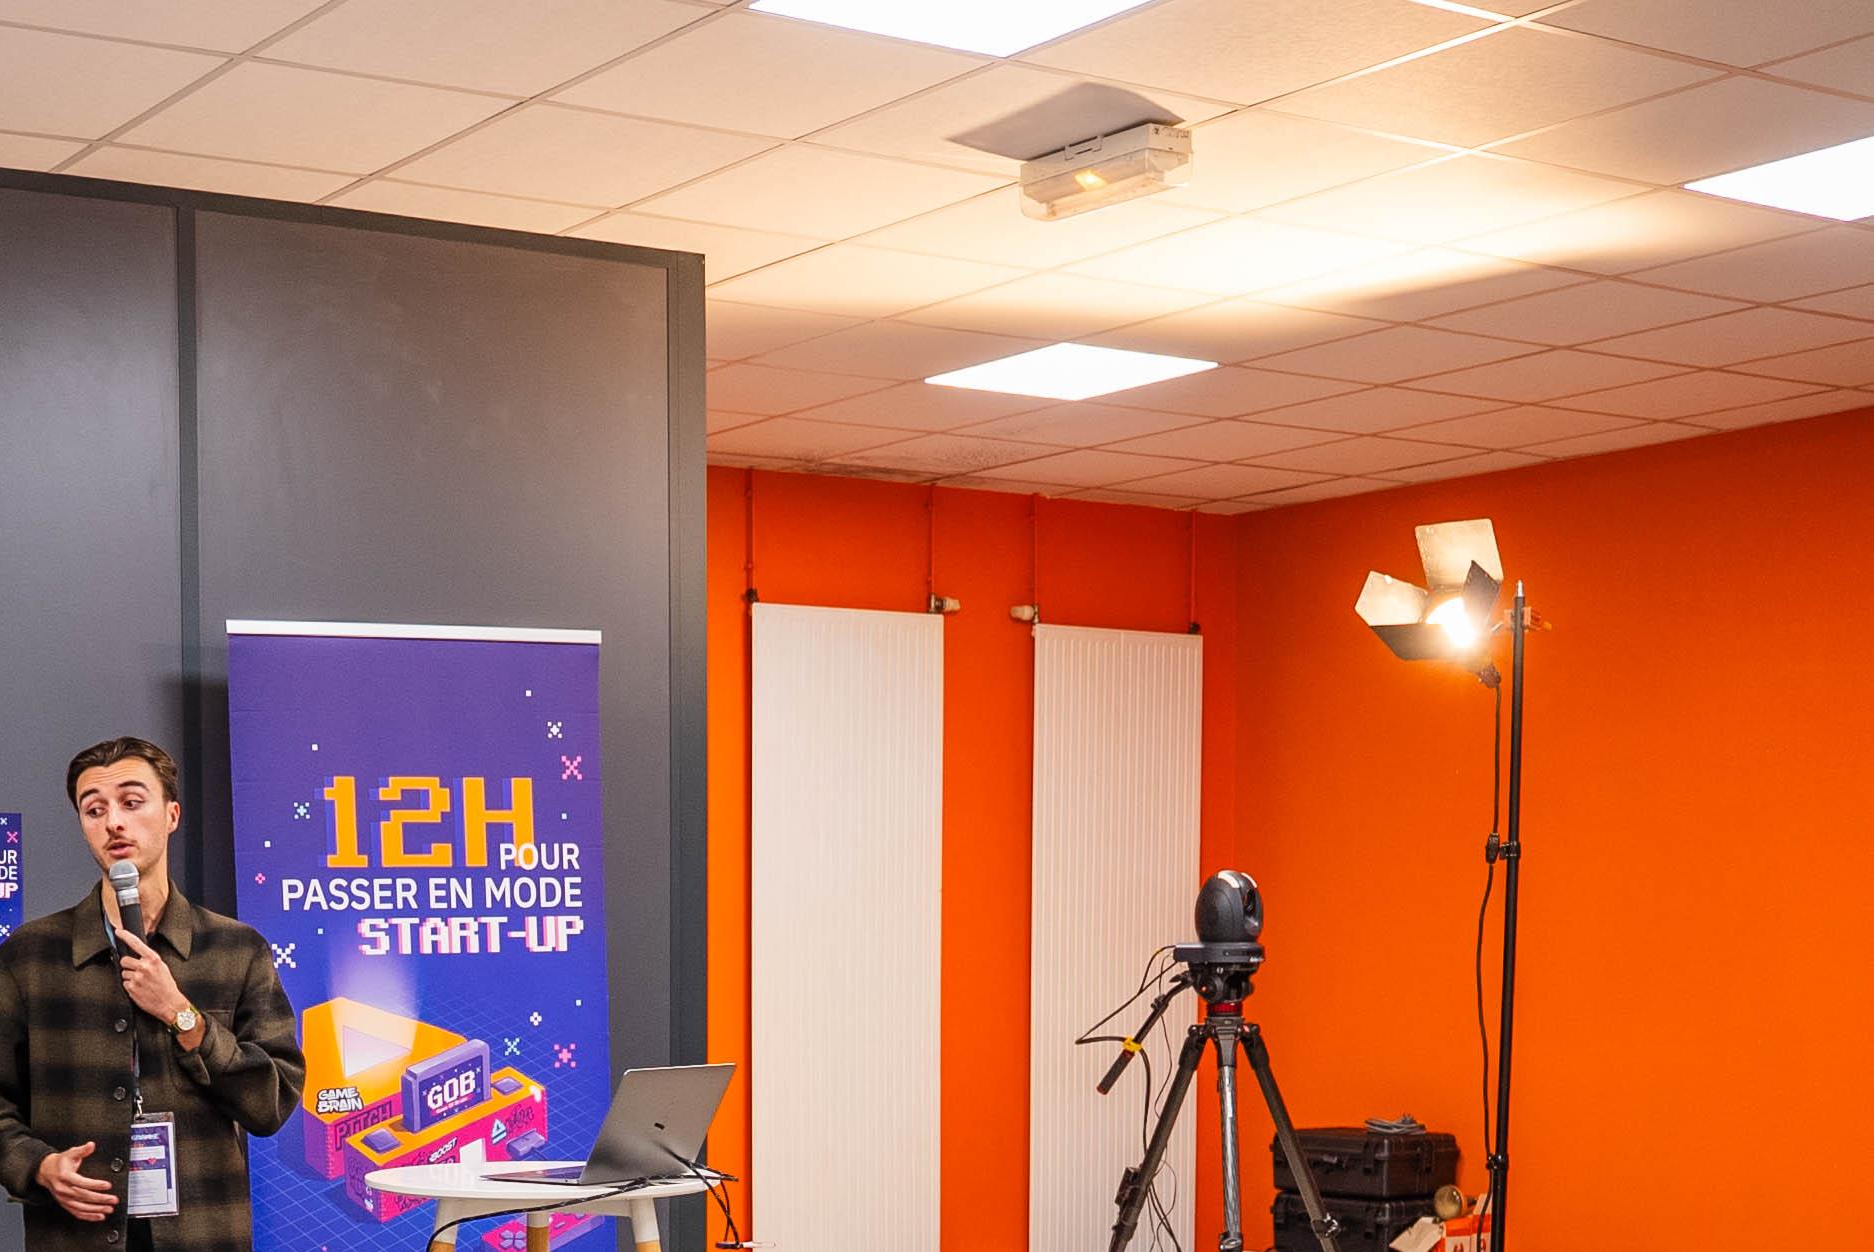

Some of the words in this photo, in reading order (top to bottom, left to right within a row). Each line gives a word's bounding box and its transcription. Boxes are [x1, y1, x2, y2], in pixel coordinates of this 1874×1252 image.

[320, 775, 536, 869] 12H
[498, 842, 581, 872] POUR
[280, 877, 420, 912] PASSER
[428, 877, 474, 909] EN
[484, 876, 584, 909] MODE
[357, 915, 585, 956] START-UP
[317, 1087, 359, 1102] GAME
[317, 1098, 364, 1113] BRAIN
[426, 1069, 477, 1110] GOB
